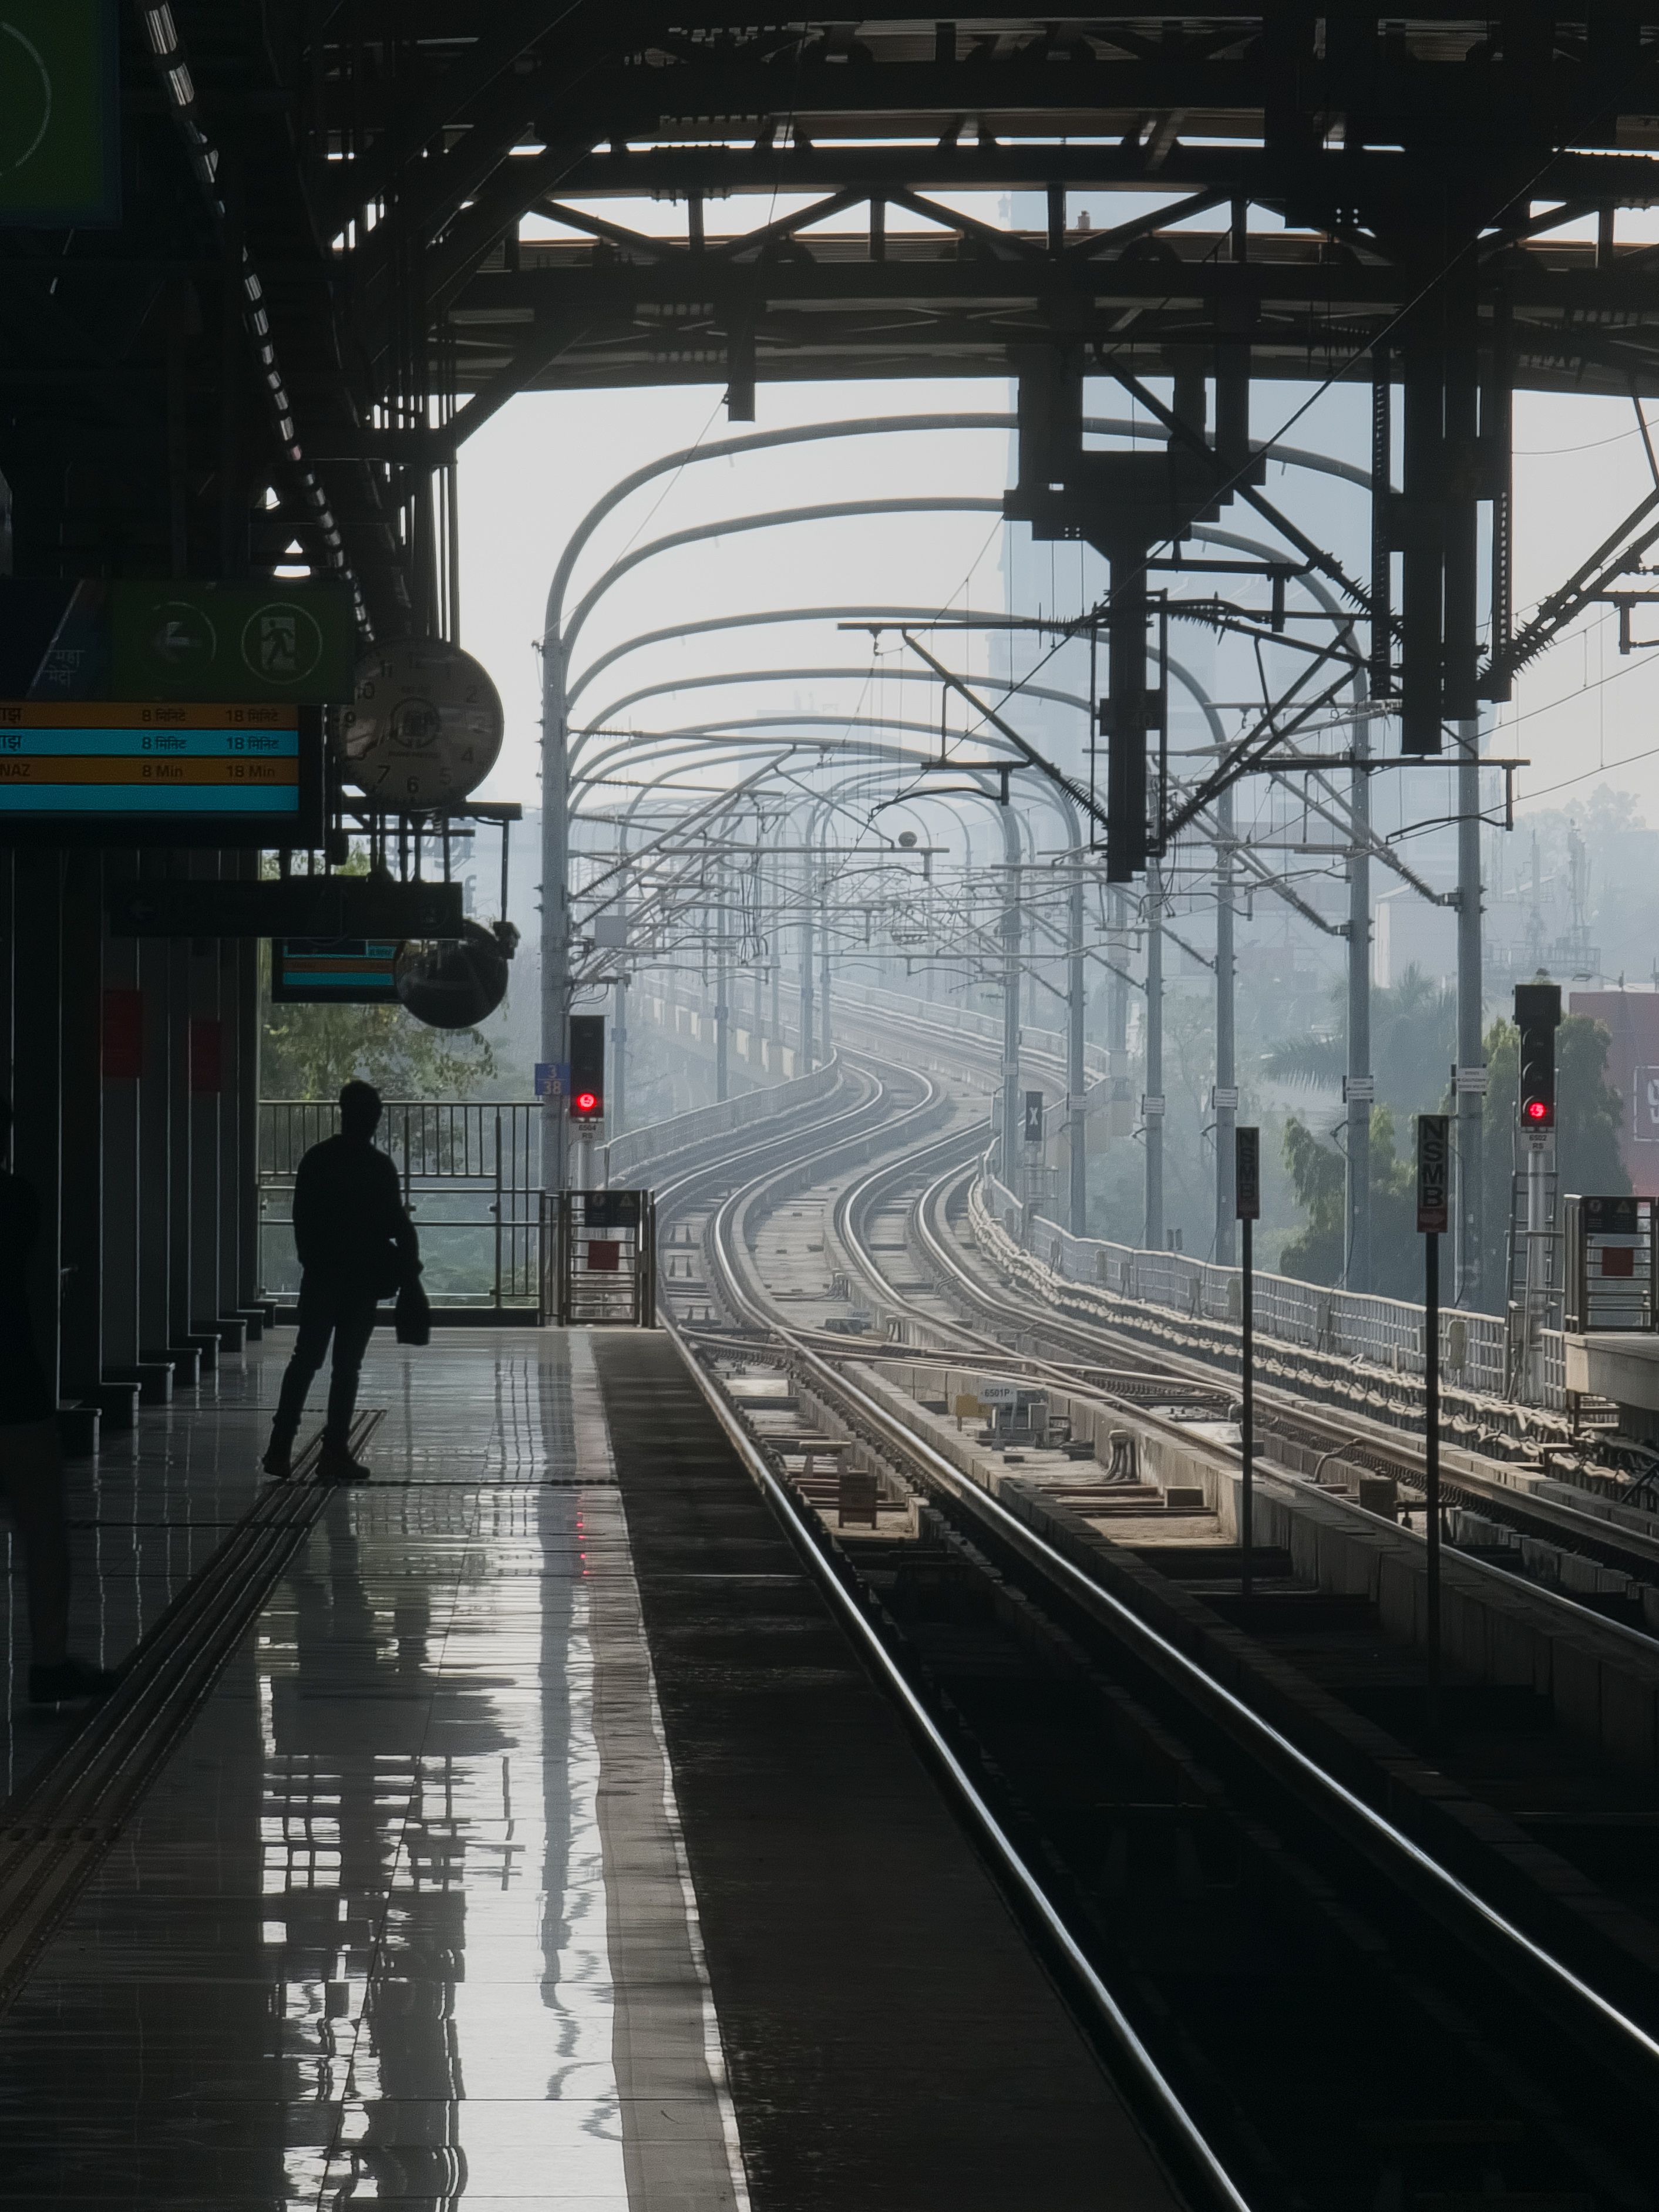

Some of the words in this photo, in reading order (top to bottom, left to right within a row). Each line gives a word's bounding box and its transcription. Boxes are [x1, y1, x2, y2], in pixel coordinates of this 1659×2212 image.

[142, 709, 152, 722] 8
[226, 709, 244, 722] 18
[142, 736, 152, 749] 8
[226, 736, 244, 749] 18
[461, 748, 474, 763] 4
[142, 765, 152, 777] 8
[157, 765, 183, 777] Min
[226, 765, 244, 778] 18
[249, 766, 275, 778] Min
[378, 765, 391, 783] 7
[407, 776, 419, 793] 6
[548, 1065, 557, 1078] 3
[544, 1080, 560, 1094] 38
[1423, 1118, 1443, 1207] NSMB
[985, 1389, 1009, 1397] 6501P
